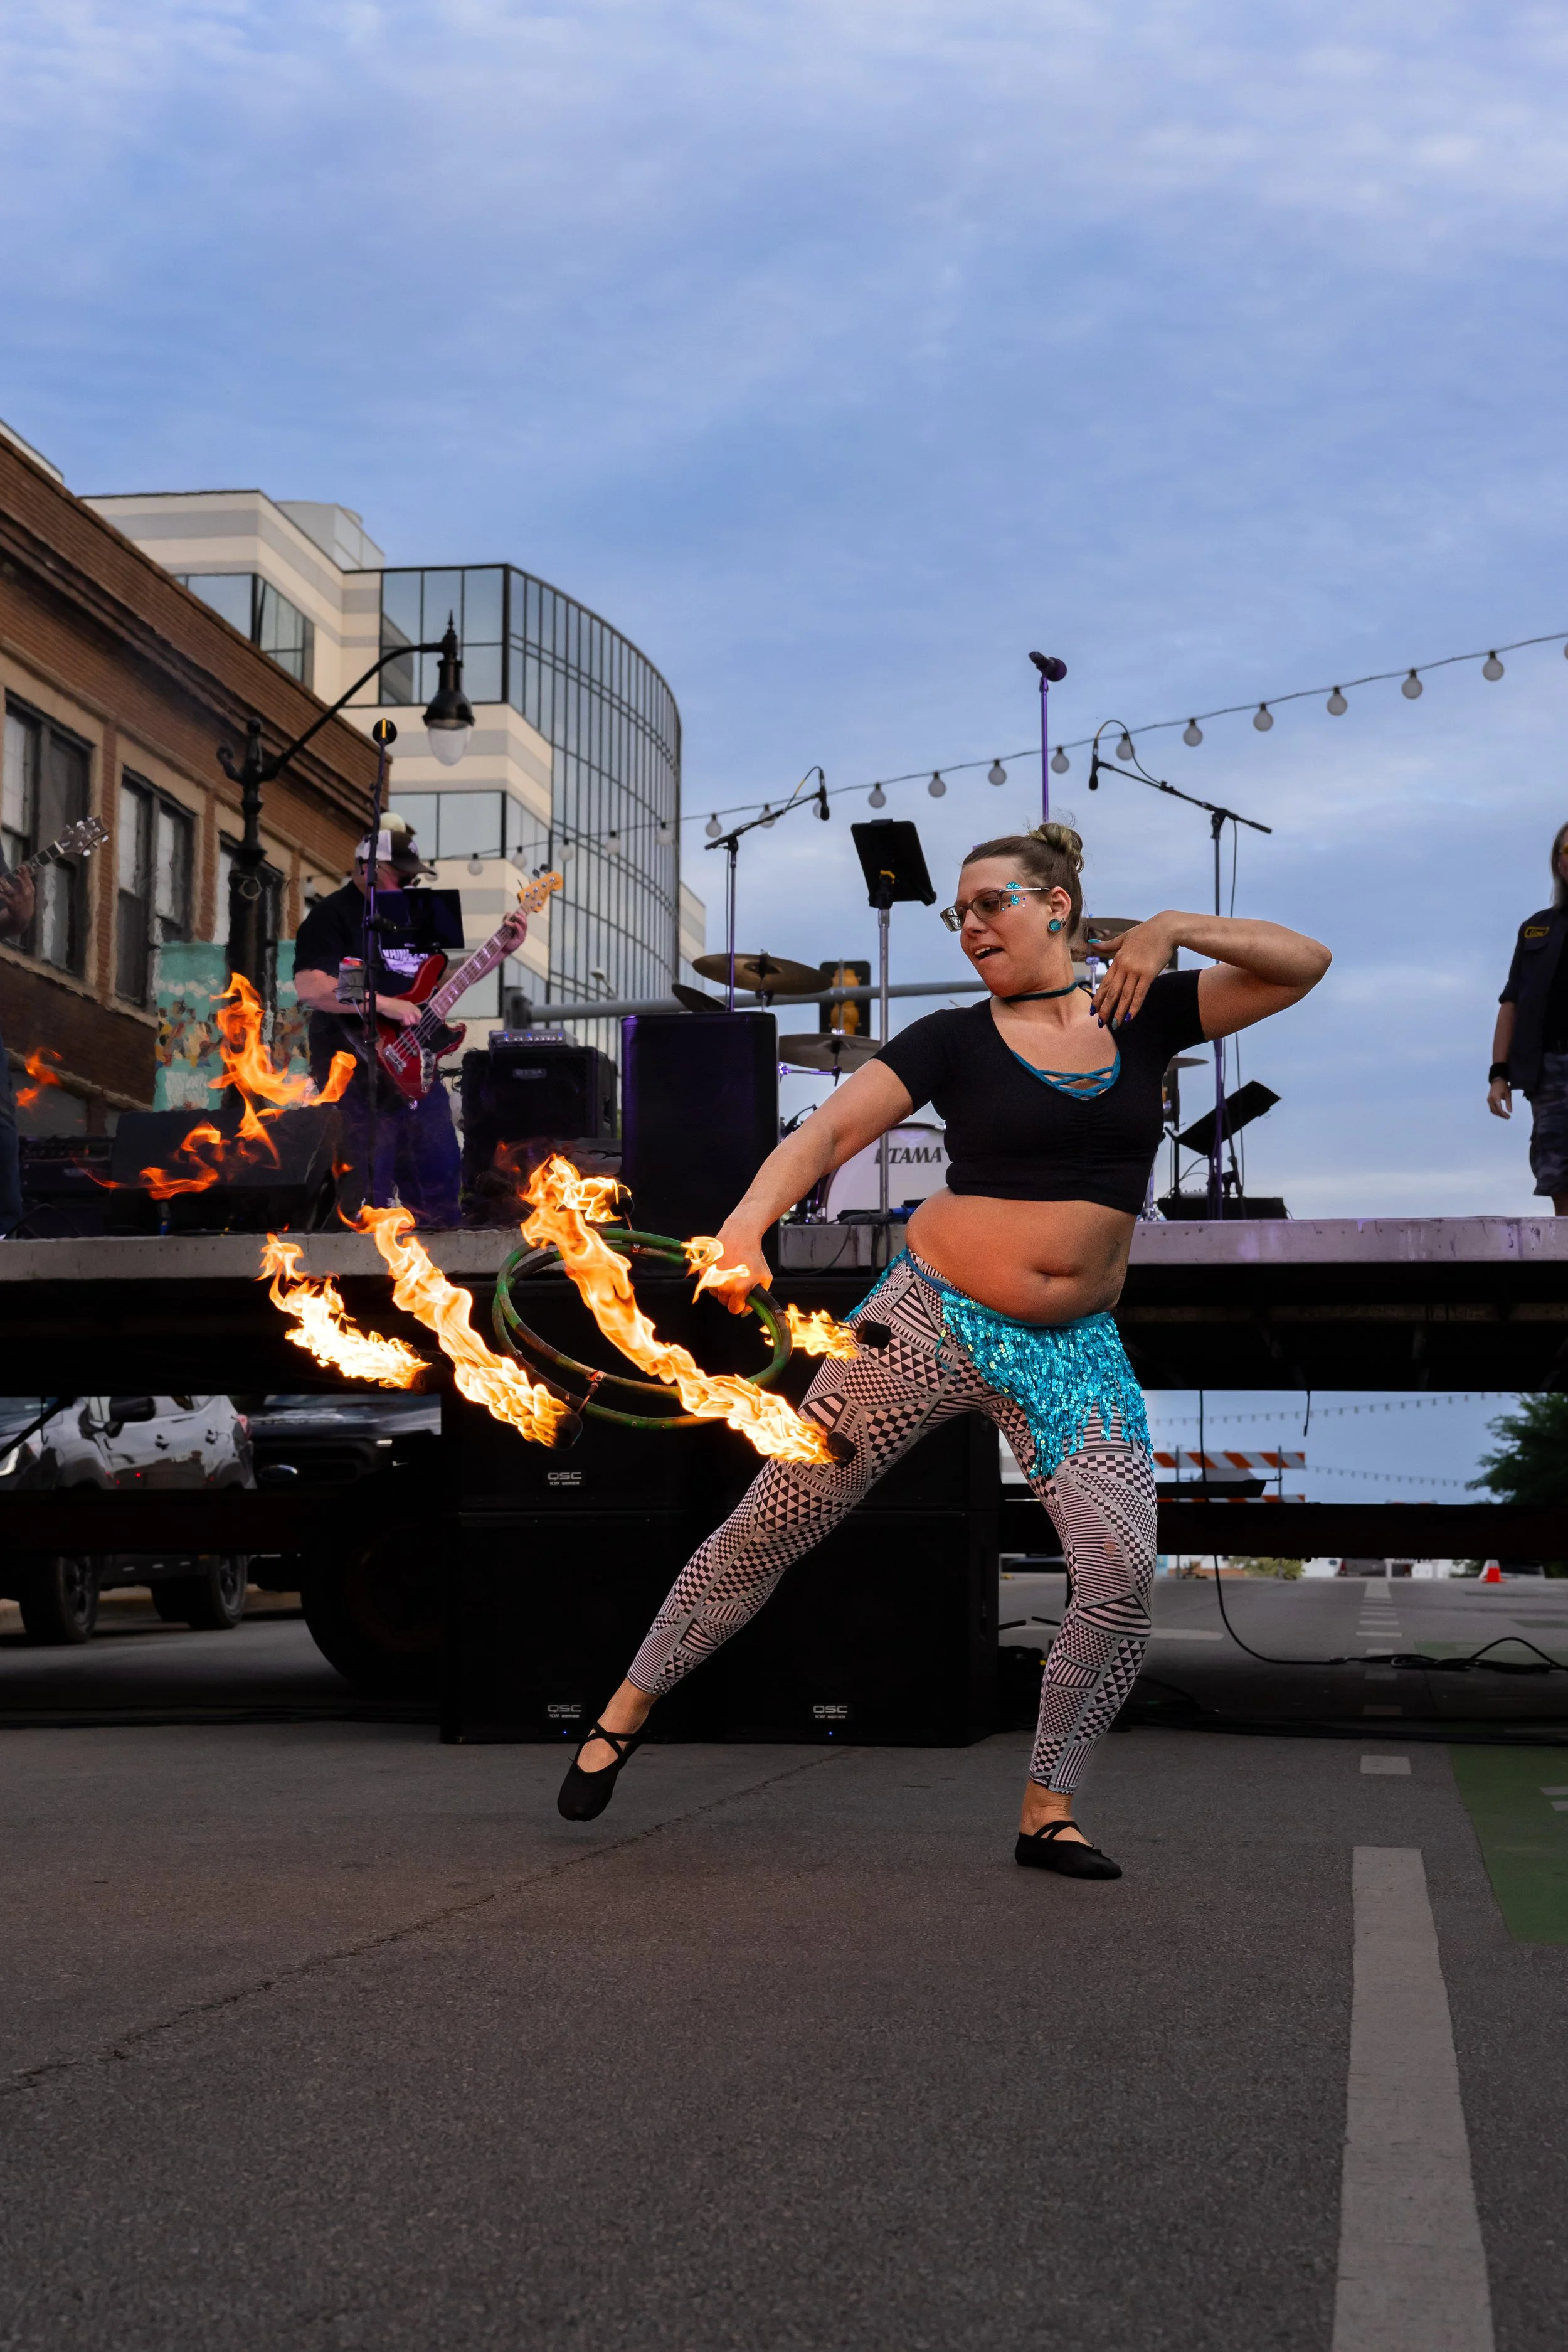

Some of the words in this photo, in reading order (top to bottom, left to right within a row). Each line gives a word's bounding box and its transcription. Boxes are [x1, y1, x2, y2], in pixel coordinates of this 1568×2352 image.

[888, 1147, 943, 1164] TAMA
[547, 1472, 582, 1481] QSC
[547, 1705, 582, 1713] QSC
[813, 1705, 848, 1713] QSC
